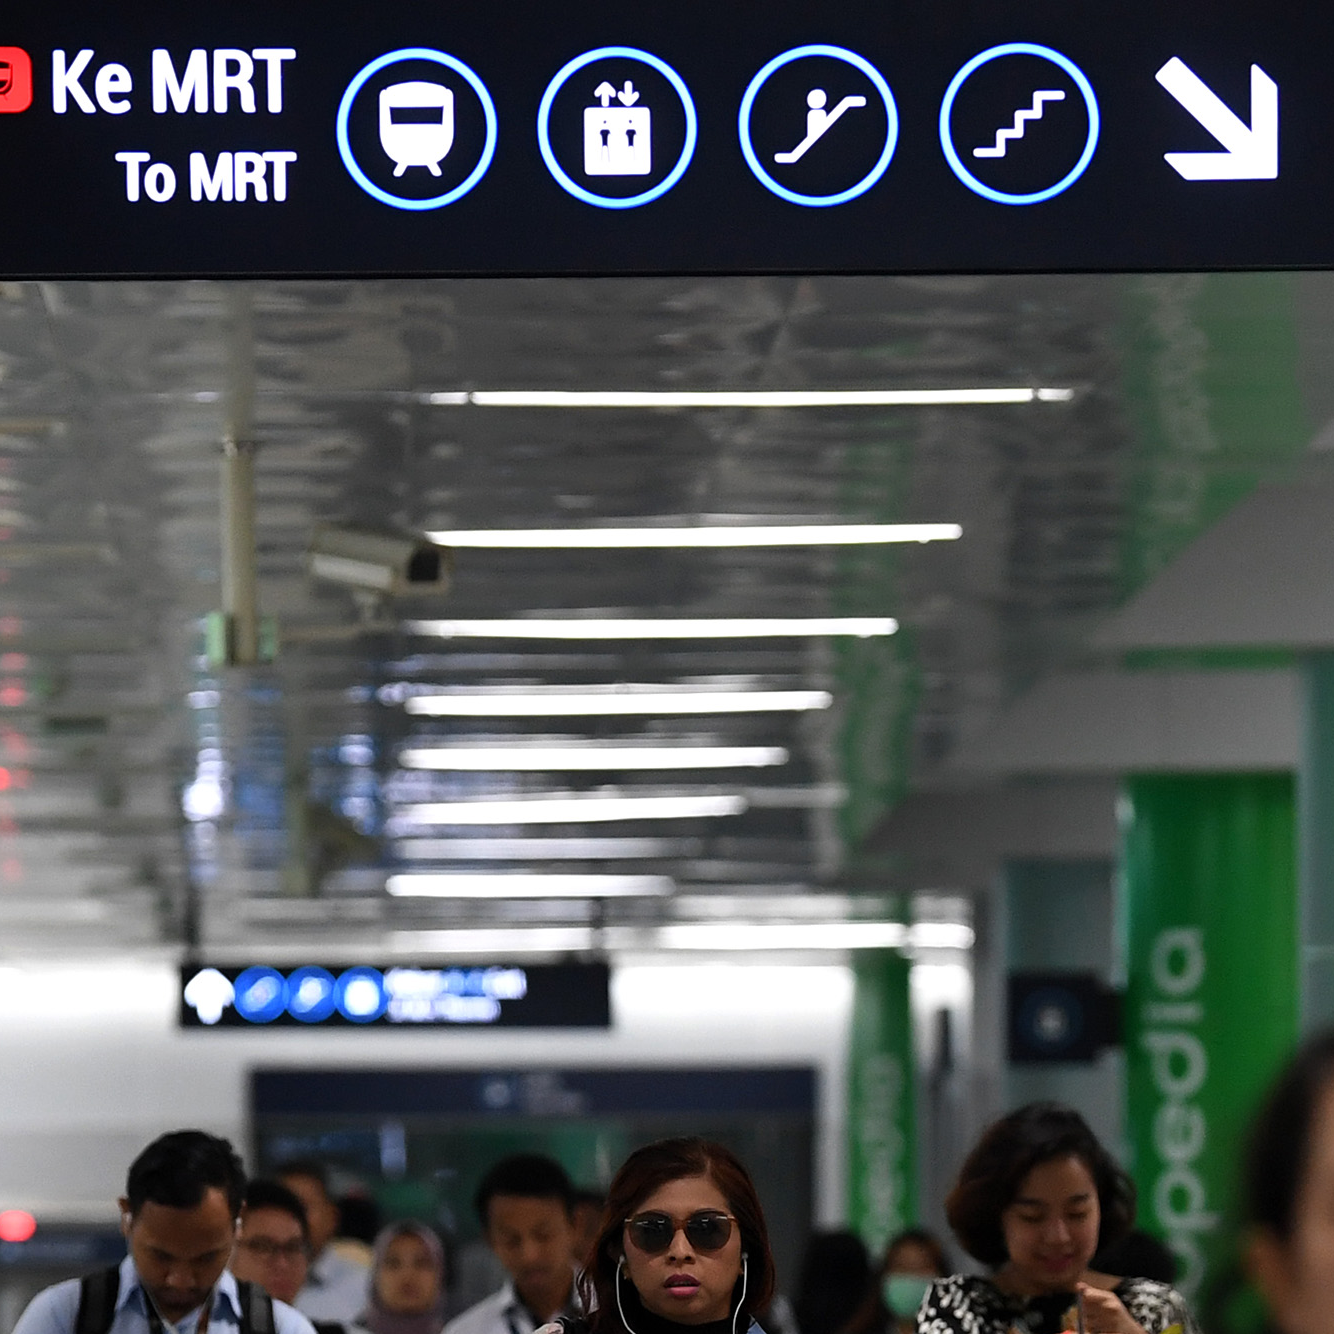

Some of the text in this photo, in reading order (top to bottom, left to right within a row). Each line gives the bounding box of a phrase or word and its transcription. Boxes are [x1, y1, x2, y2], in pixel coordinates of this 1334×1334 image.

[51, 47, 297, 114] Ke MRT
[114, 151, 298, 203] To MRT
